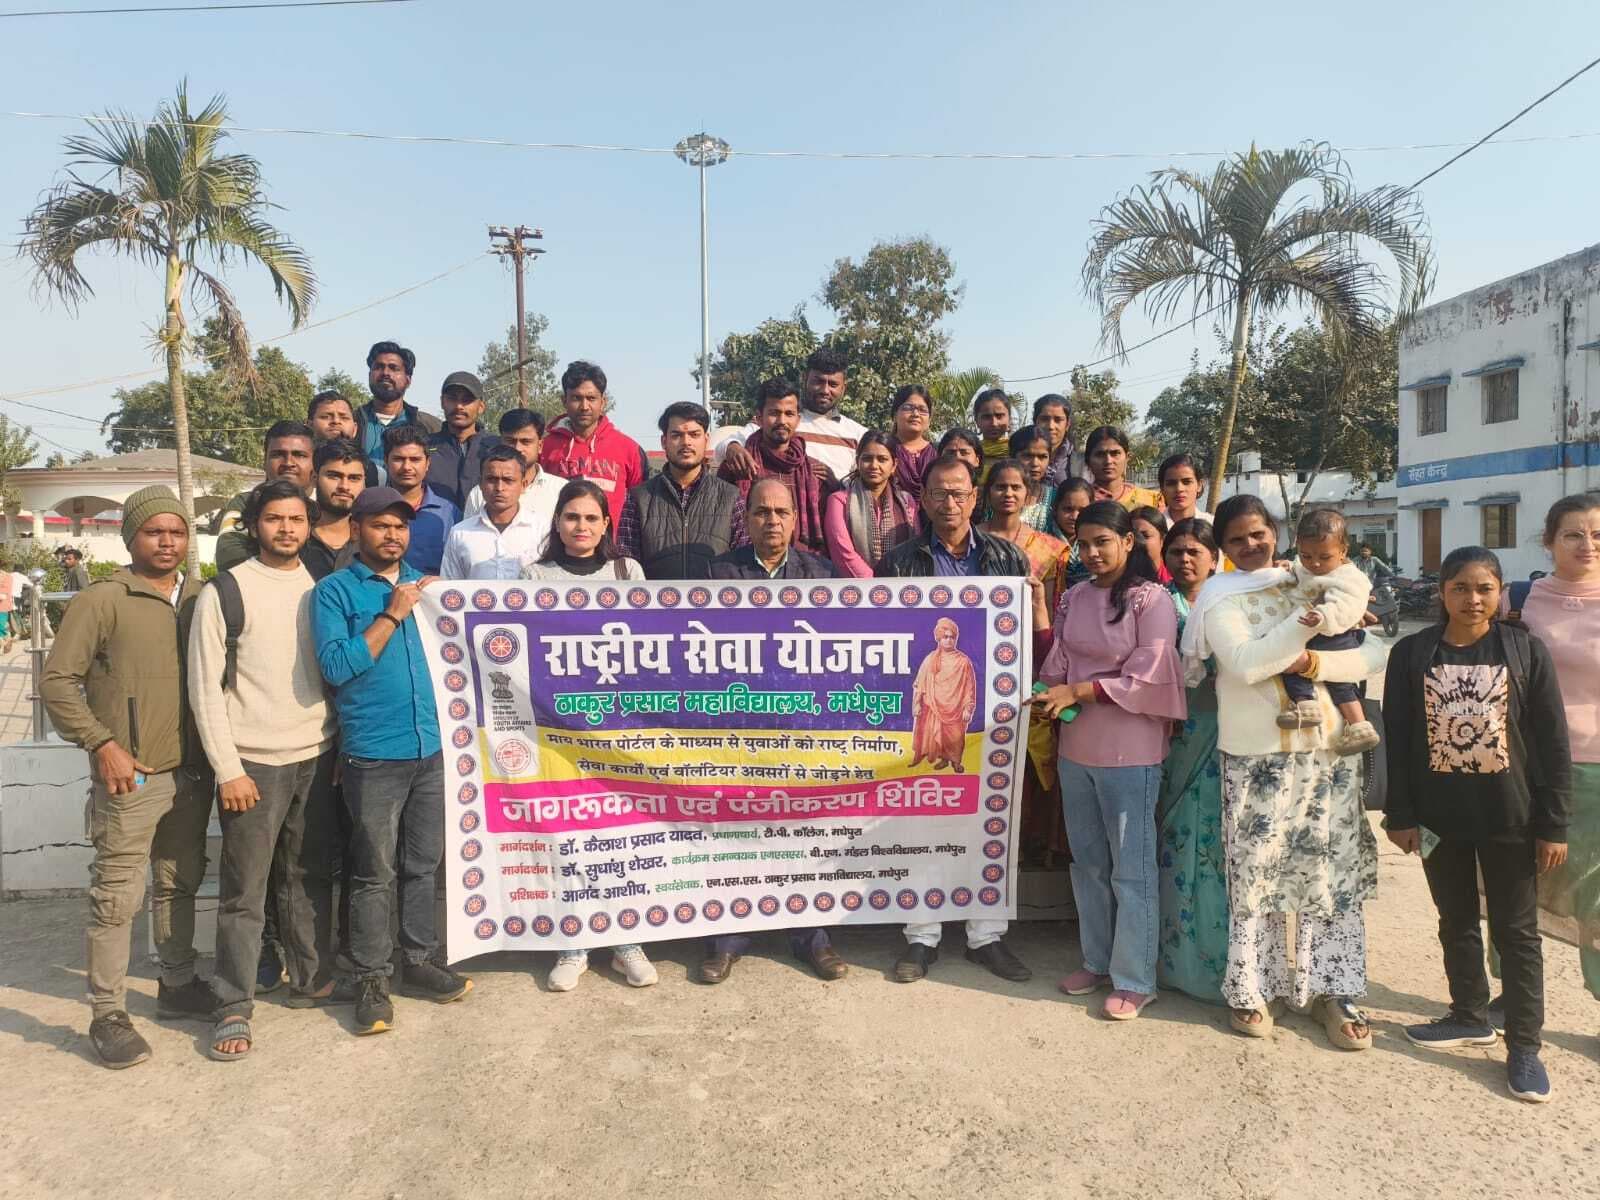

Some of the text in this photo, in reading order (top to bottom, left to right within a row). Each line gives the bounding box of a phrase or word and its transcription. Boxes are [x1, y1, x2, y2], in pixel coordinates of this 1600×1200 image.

[540, 622, 674, 684] राष्ट्रीय
[680, 621, 766, 674] सेवा
[773, 620, 914, 674] योजना
[554, 682, 903, 725] ठाकुर प्रसाद महाविद्यालय, मधेपुरा
[546, 732, 904, 755] माय भारत पोर्टल के माध्यम से युवाओं को राष्ट्र निर्माण,
[577, 757, 606, 772] सेवा
[609, 761, 644, 776] कार्यों
[647, 764, 670, 780] एवं
[672, 763, 737, 778] वॉलंटियर
[740, 764, 791, 778] अवसरों
[793, 766, 808, 780] से
[810, 765, 851, 783] जोड़ने
[502, 779, 965, 824] जागरूकता एवं पंजीकरण शिविर
[500, 839, 546, 853] मार्गदर्शन
[558, 838, 580, 857] डॉ.
[583, 835, 628, 853] कैलाश
[631, 831, 667, 850] प्रसाद
[669, 828, 708, 843] यादव,
[793, 825, 829, 839] कॉलेज,
[831, 825, 864, 840] मधेपुरा
[501, 864, 549, 876] मार्गदर्शन
[560, 861, 582, 878] डॉ.
[585, 858, 626, 880] सुधांशु
[628, 855, 668, 872] शेखर,
[671, 852, 709, 866] कार्यक्रम
[934, 844, 967, 857] मधेपुरा
[561, 885, 600, 902] आनंद
[602, 881, 650, 900] आशीष,
[764, 873, 790, 887] ठाकुर
[791, 873, 817, 884] प्रसाद
[818, 868, 876, 882] महाविद्यालय,
[878, 867, 909, 881] मधेपुरा
